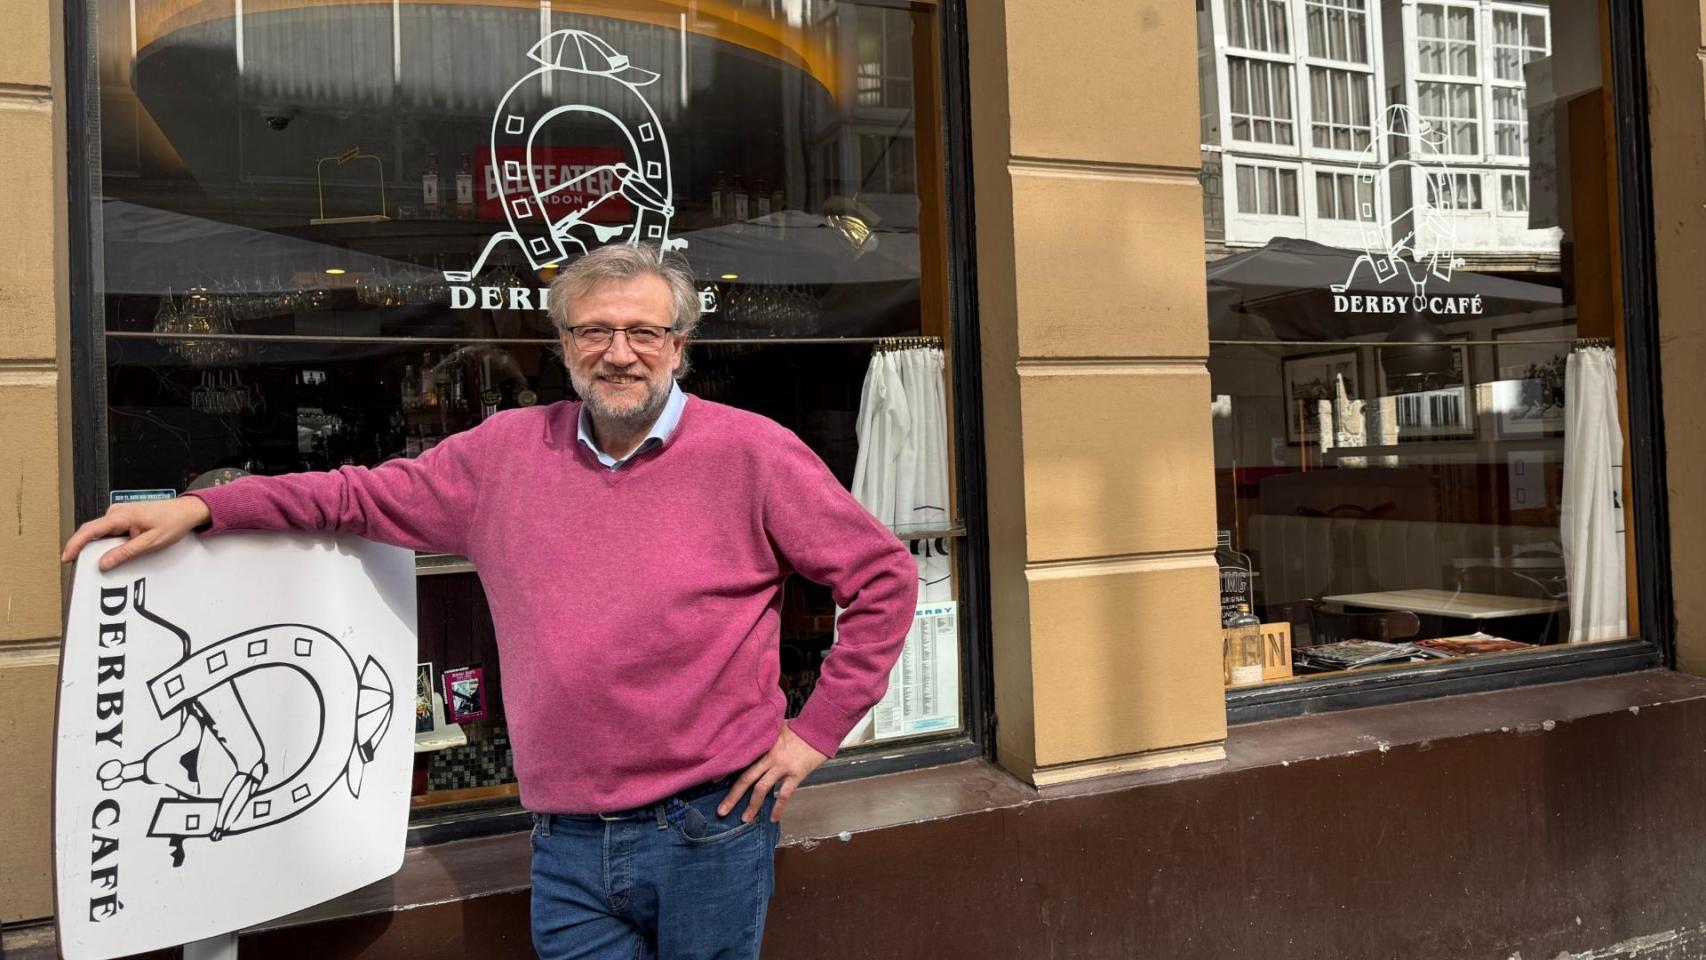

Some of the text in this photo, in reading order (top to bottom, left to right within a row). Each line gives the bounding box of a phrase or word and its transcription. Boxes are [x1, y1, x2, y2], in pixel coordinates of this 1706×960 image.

[484, 164, 616, 200] BEEFEATER
[520, 194, 583, 205] LONDON
[449, 286, 550, 310] DER
[1333, 294, 1483, 315] DERBY CAFÉ
[915, 607, 952, 616] ERBY
[89, 584, 128, 922] DERBY CAFÉ
